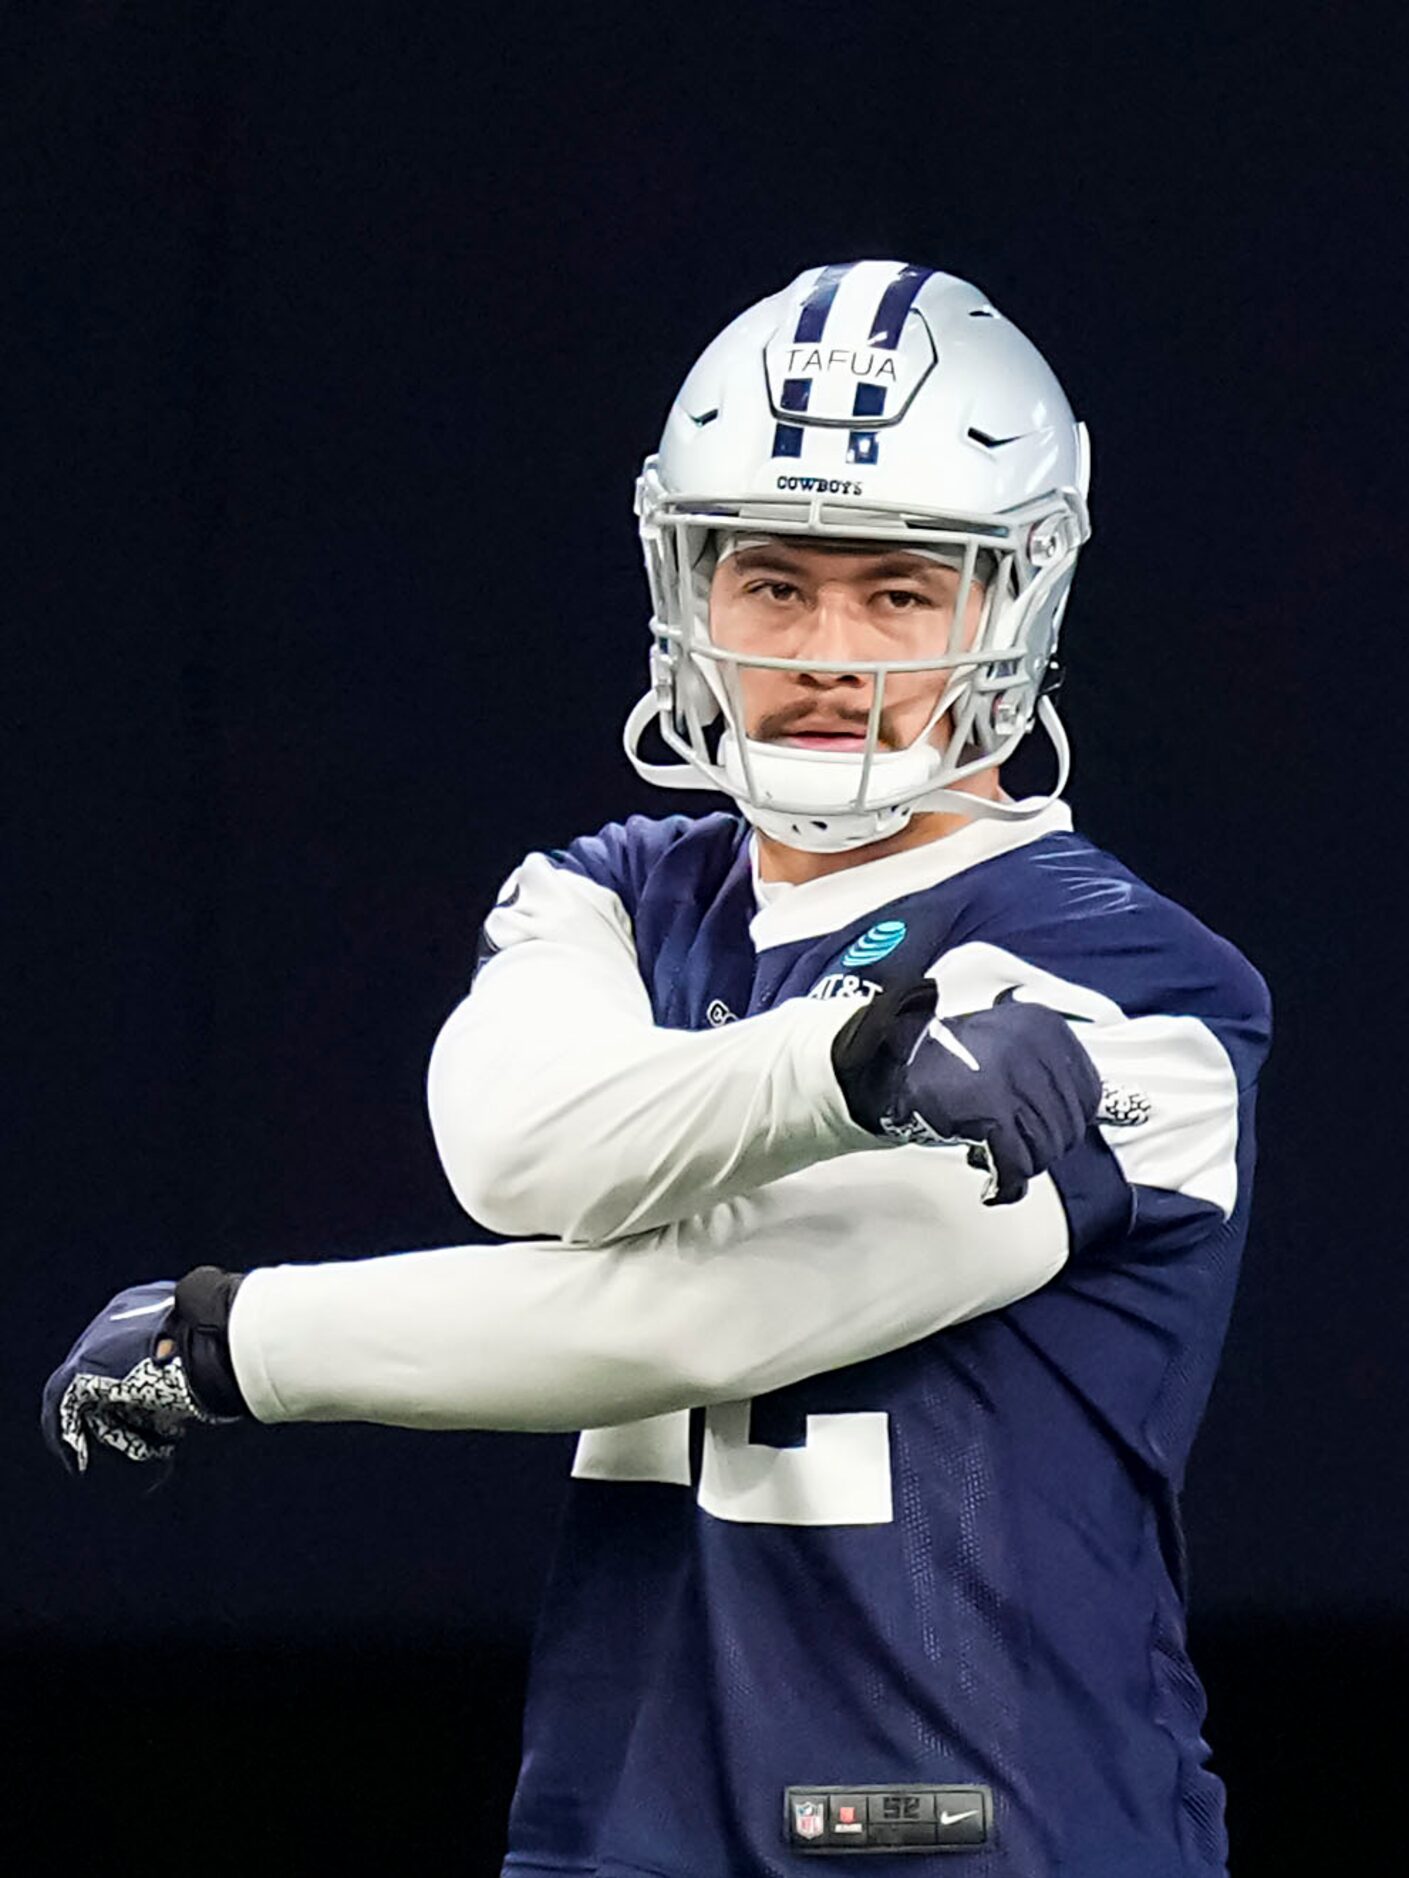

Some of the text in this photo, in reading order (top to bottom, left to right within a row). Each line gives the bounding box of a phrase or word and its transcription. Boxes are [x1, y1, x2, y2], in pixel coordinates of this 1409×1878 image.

[787, 349, 896, 382] TAFUA
[776, 476, 862, 495] COWBOYS
[883, 1797, 920, 1819] 52
